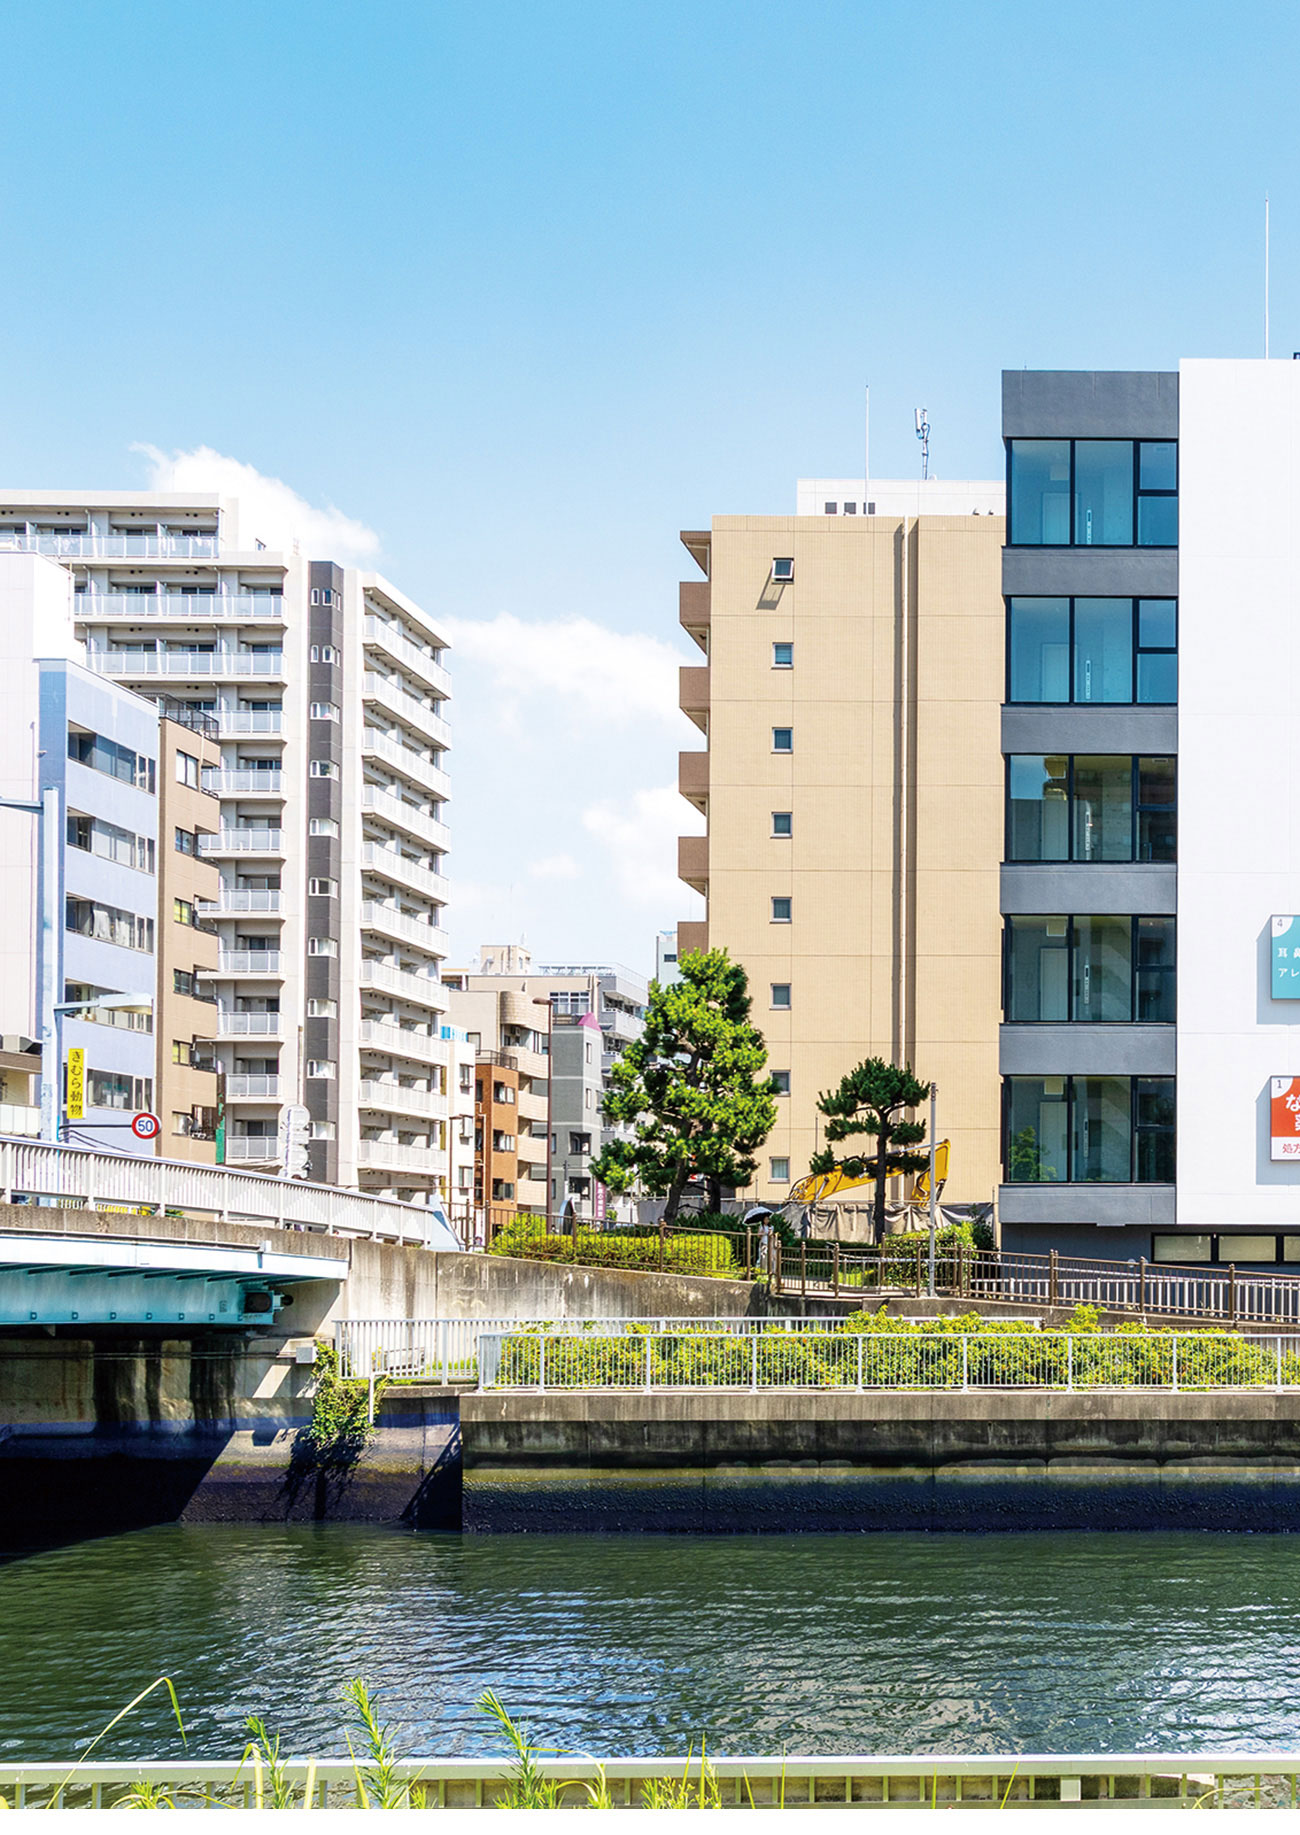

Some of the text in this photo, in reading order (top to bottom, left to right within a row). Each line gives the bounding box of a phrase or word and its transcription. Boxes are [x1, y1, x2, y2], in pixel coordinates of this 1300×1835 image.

[1277, 918, 1283, 927] 4
[1277, 1080, 1281, 1089] 1
[137, 1120, 154, 1132] 50
